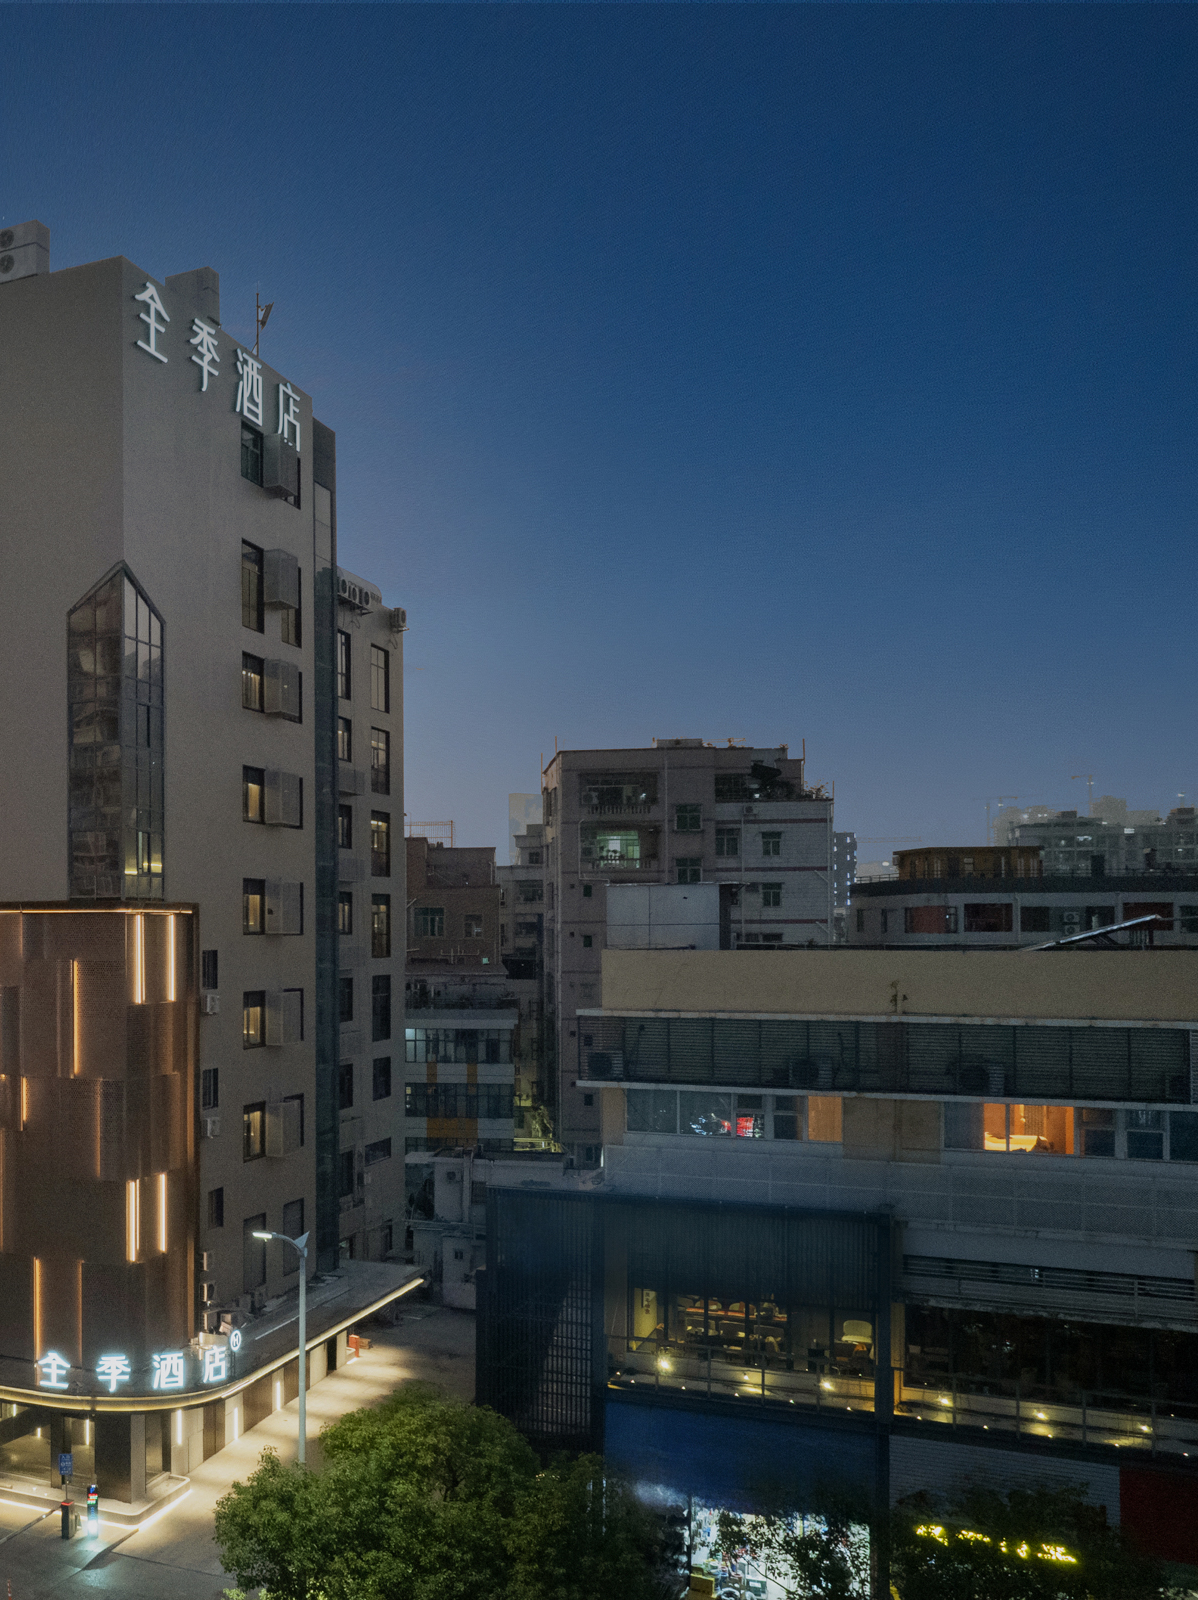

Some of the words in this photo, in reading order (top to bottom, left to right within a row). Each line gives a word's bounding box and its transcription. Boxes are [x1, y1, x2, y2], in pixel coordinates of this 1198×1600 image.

[135, 281, 301, 452] 全季酒店
[38, 1346, 227, 1392] 全季酒店
